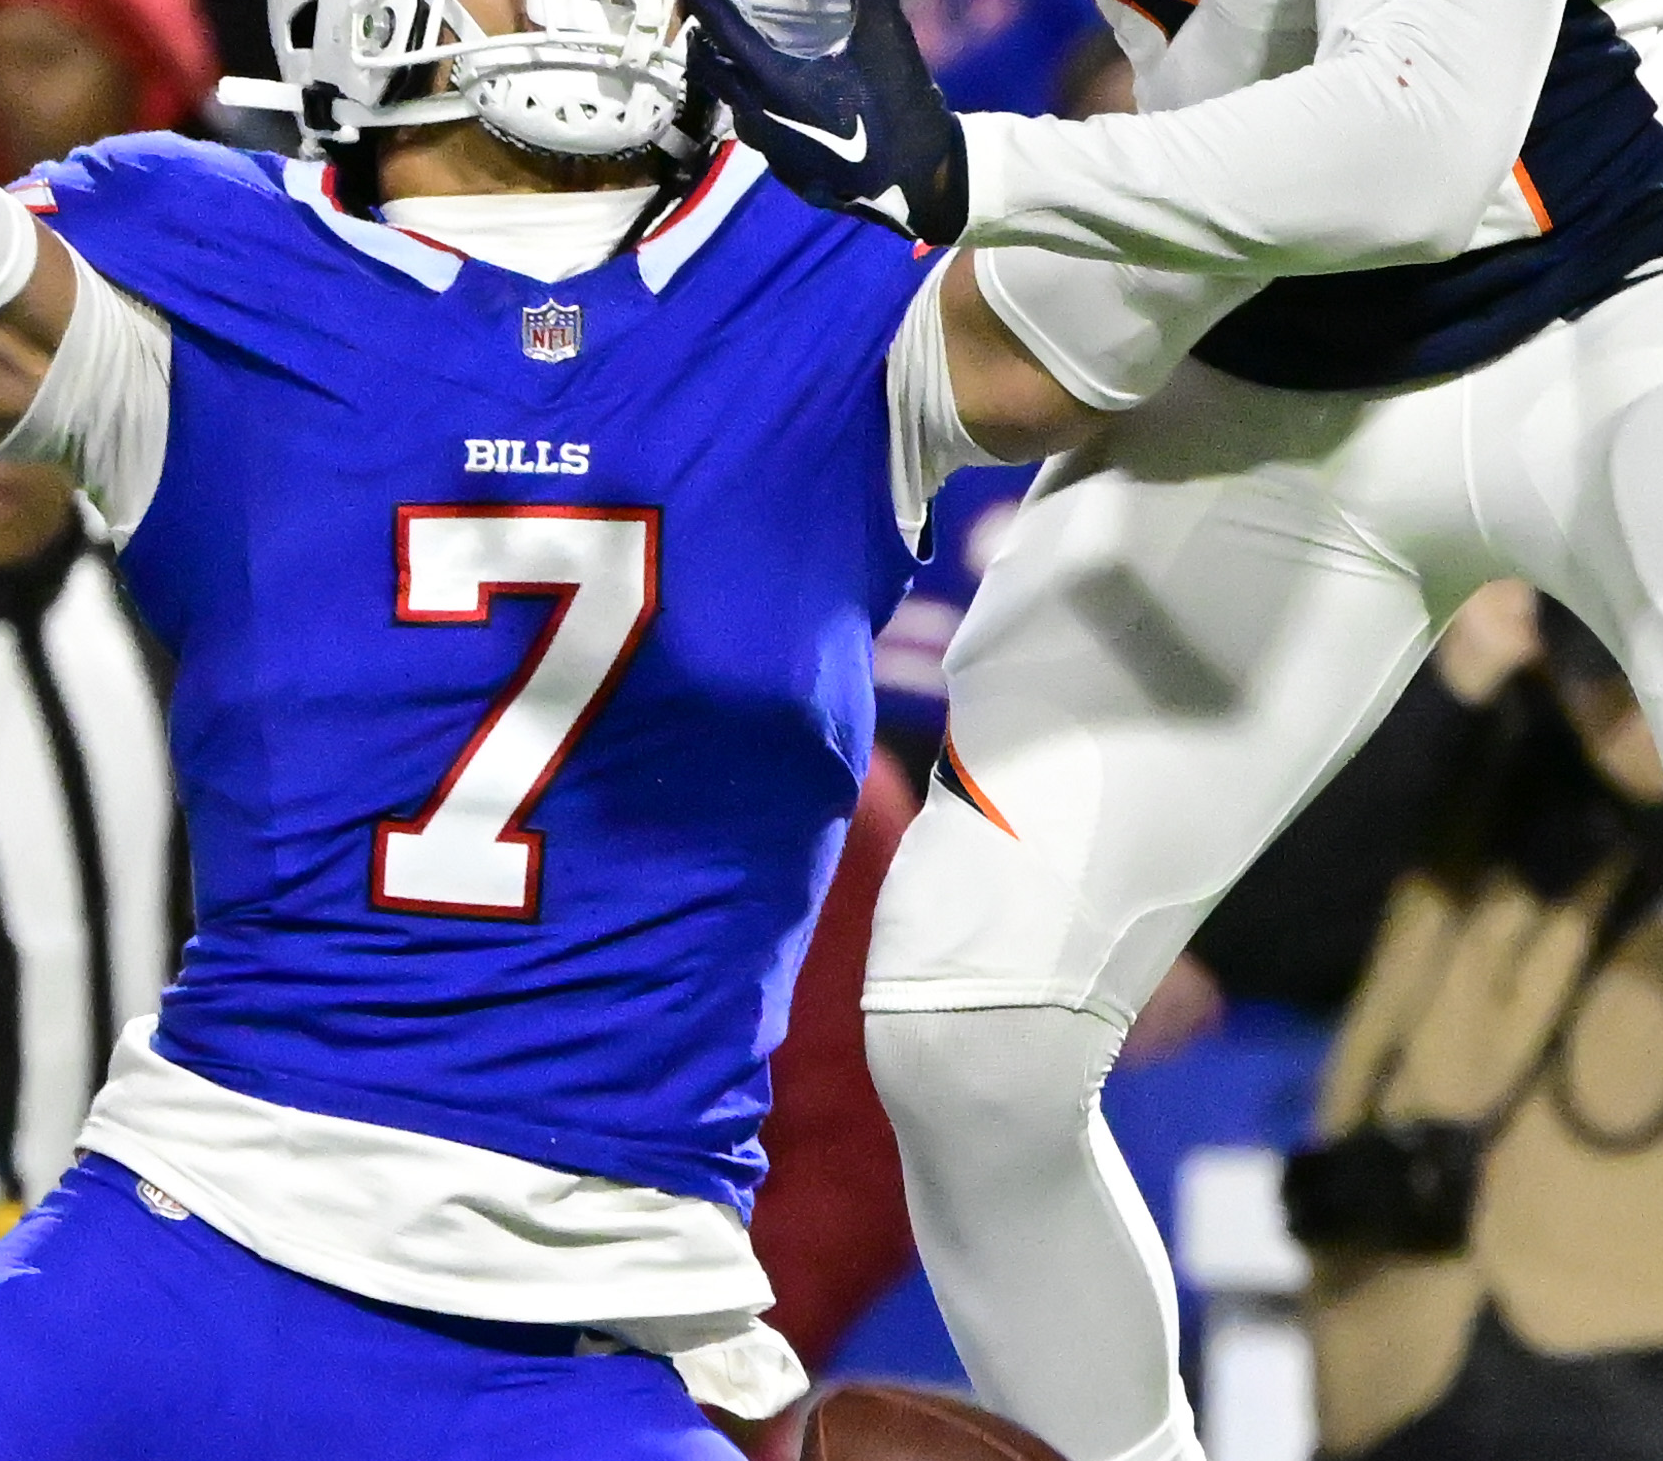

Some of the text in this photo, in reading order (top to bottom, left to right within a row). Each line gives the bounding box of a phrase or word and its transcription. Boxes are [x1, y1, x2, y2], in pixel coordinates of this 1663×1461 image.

[531, 328, 572, 350] NFL
[464, 439, 591, 476] BILLS
[370, 502, 663, 921] 7
